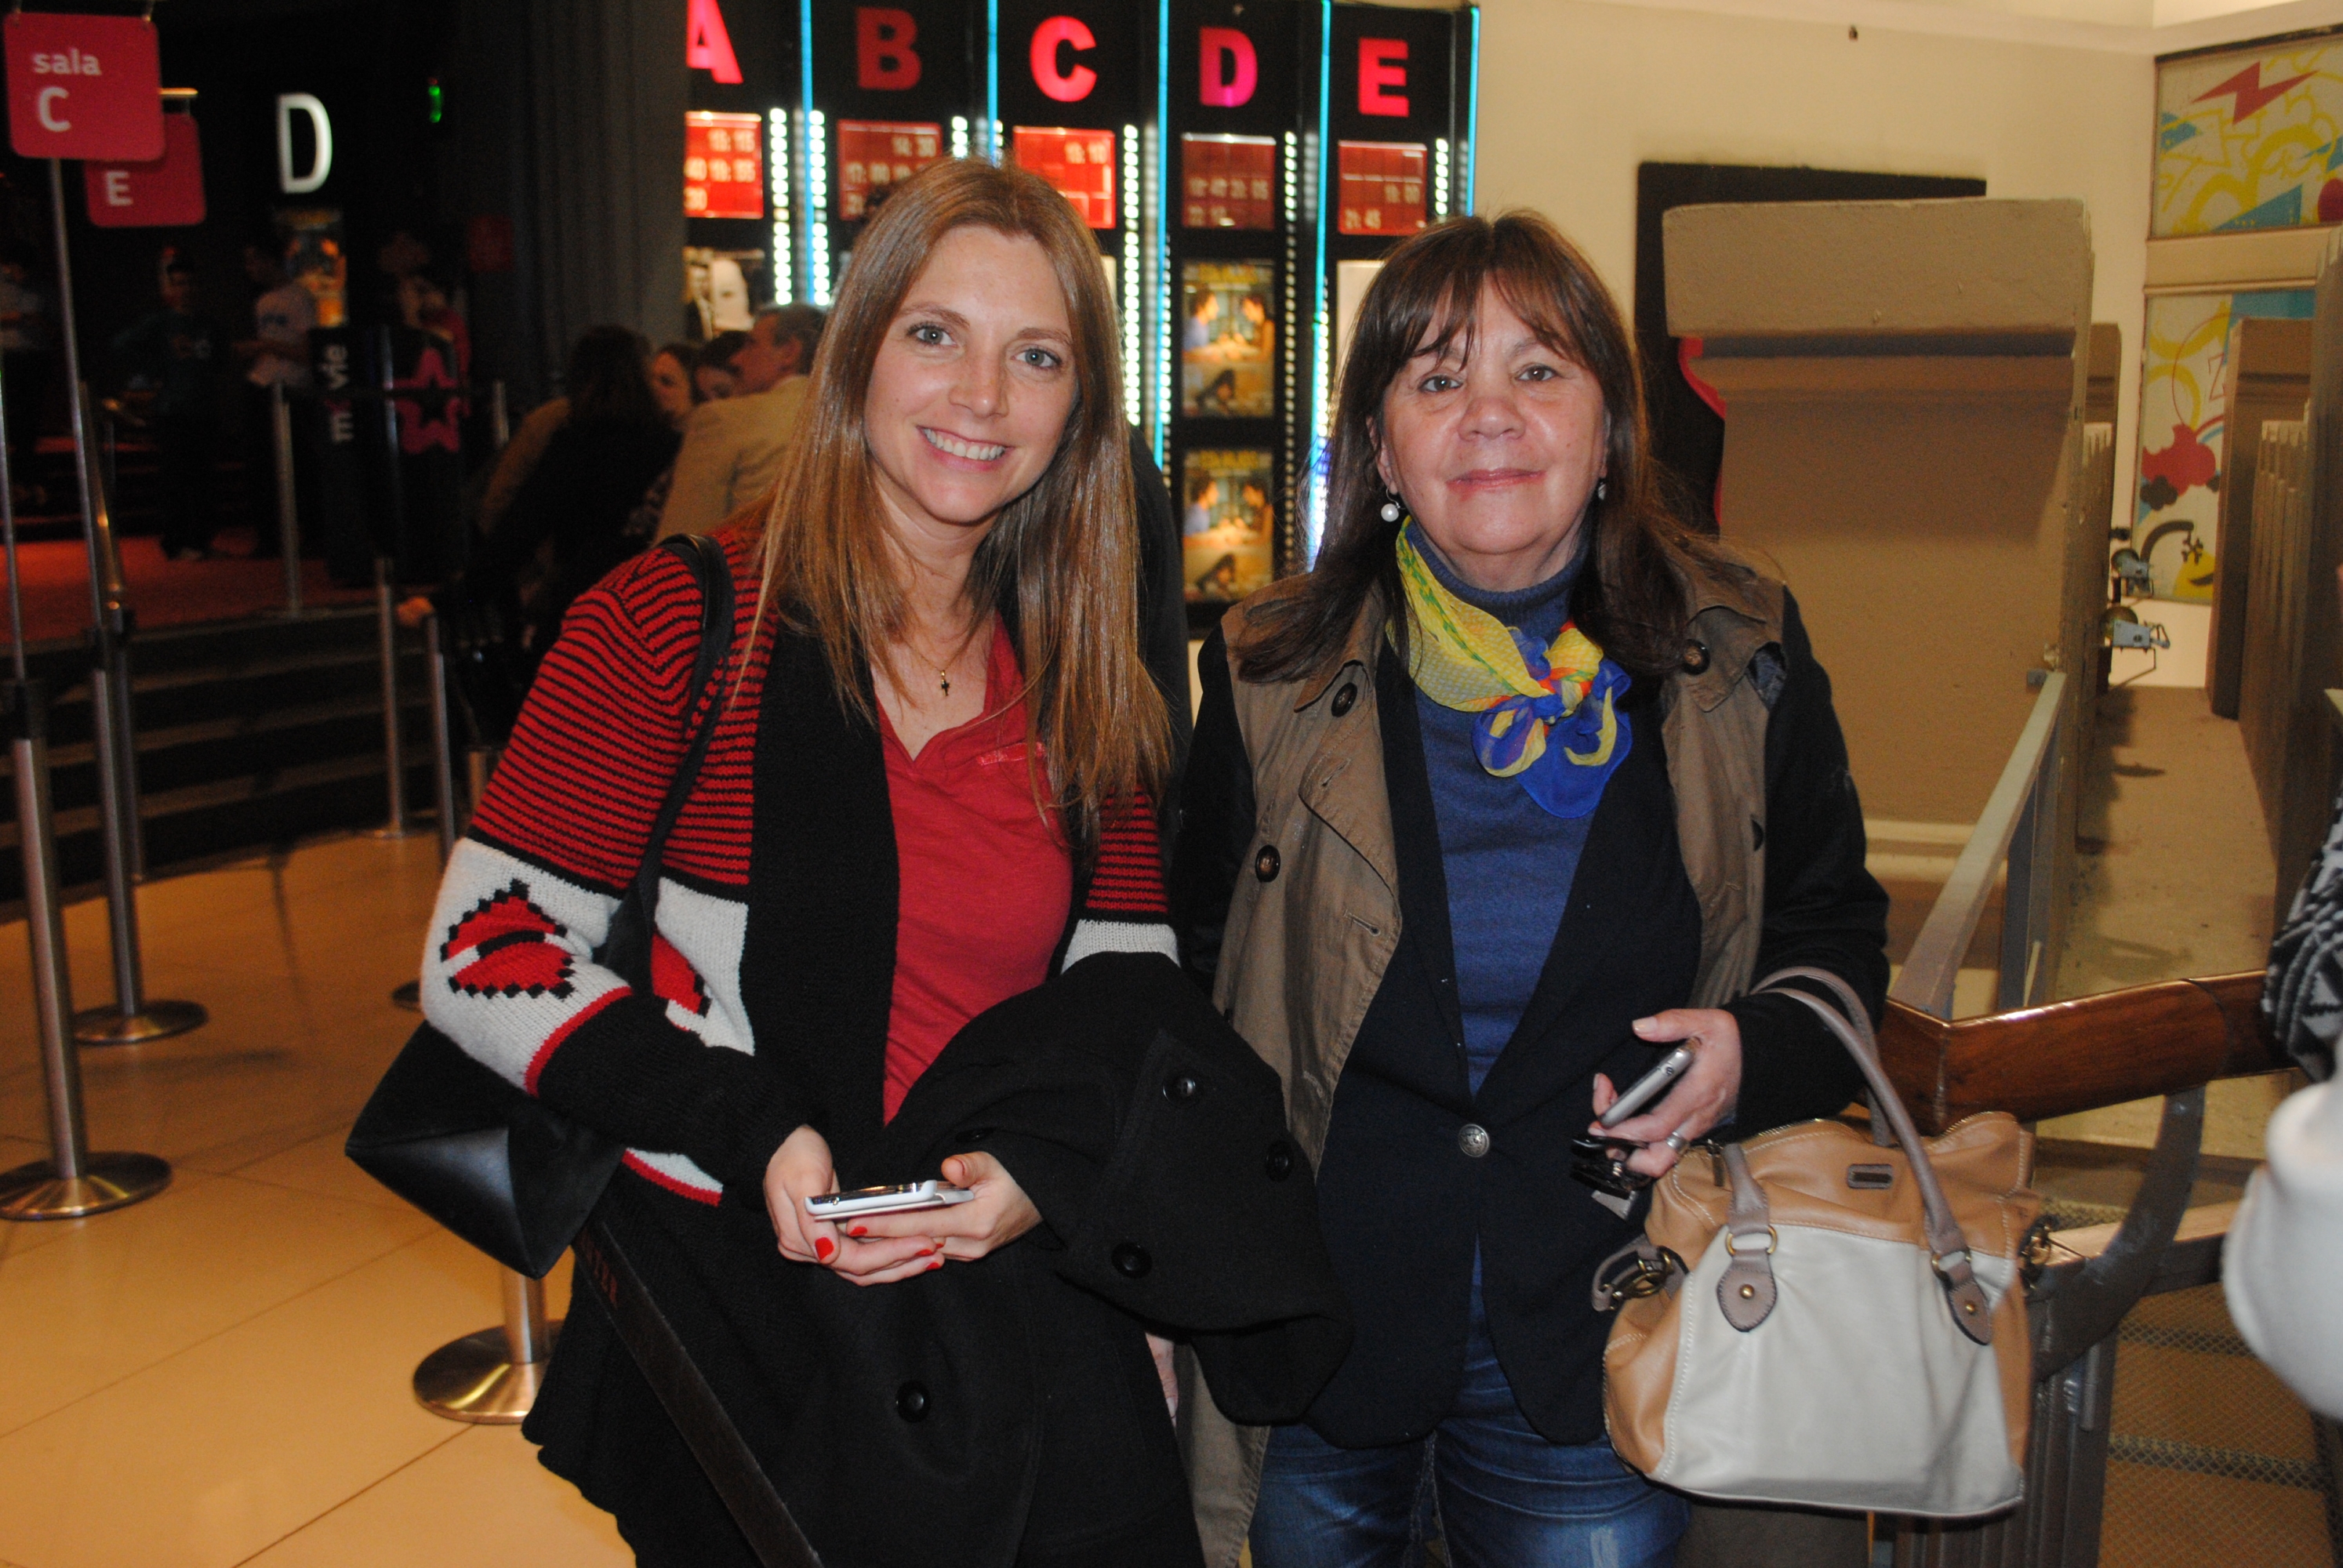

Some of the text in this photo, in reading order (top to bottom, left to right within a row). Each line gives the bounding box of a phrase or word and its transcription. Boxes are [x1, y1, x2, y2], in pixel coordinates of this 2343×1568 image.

[31, 48, 102, 76] sala
[686, 0, 743, 85] A
[856, 7, 922, 91] B
[1030, 16, 1097, 103] C
[1200, 28, 1259, 108] D
[1358, 38, 1410, 118] E
[37, 85, 71, 132] C
[278, 93, 333, 194] D
[104, 170, 133, 206] E
